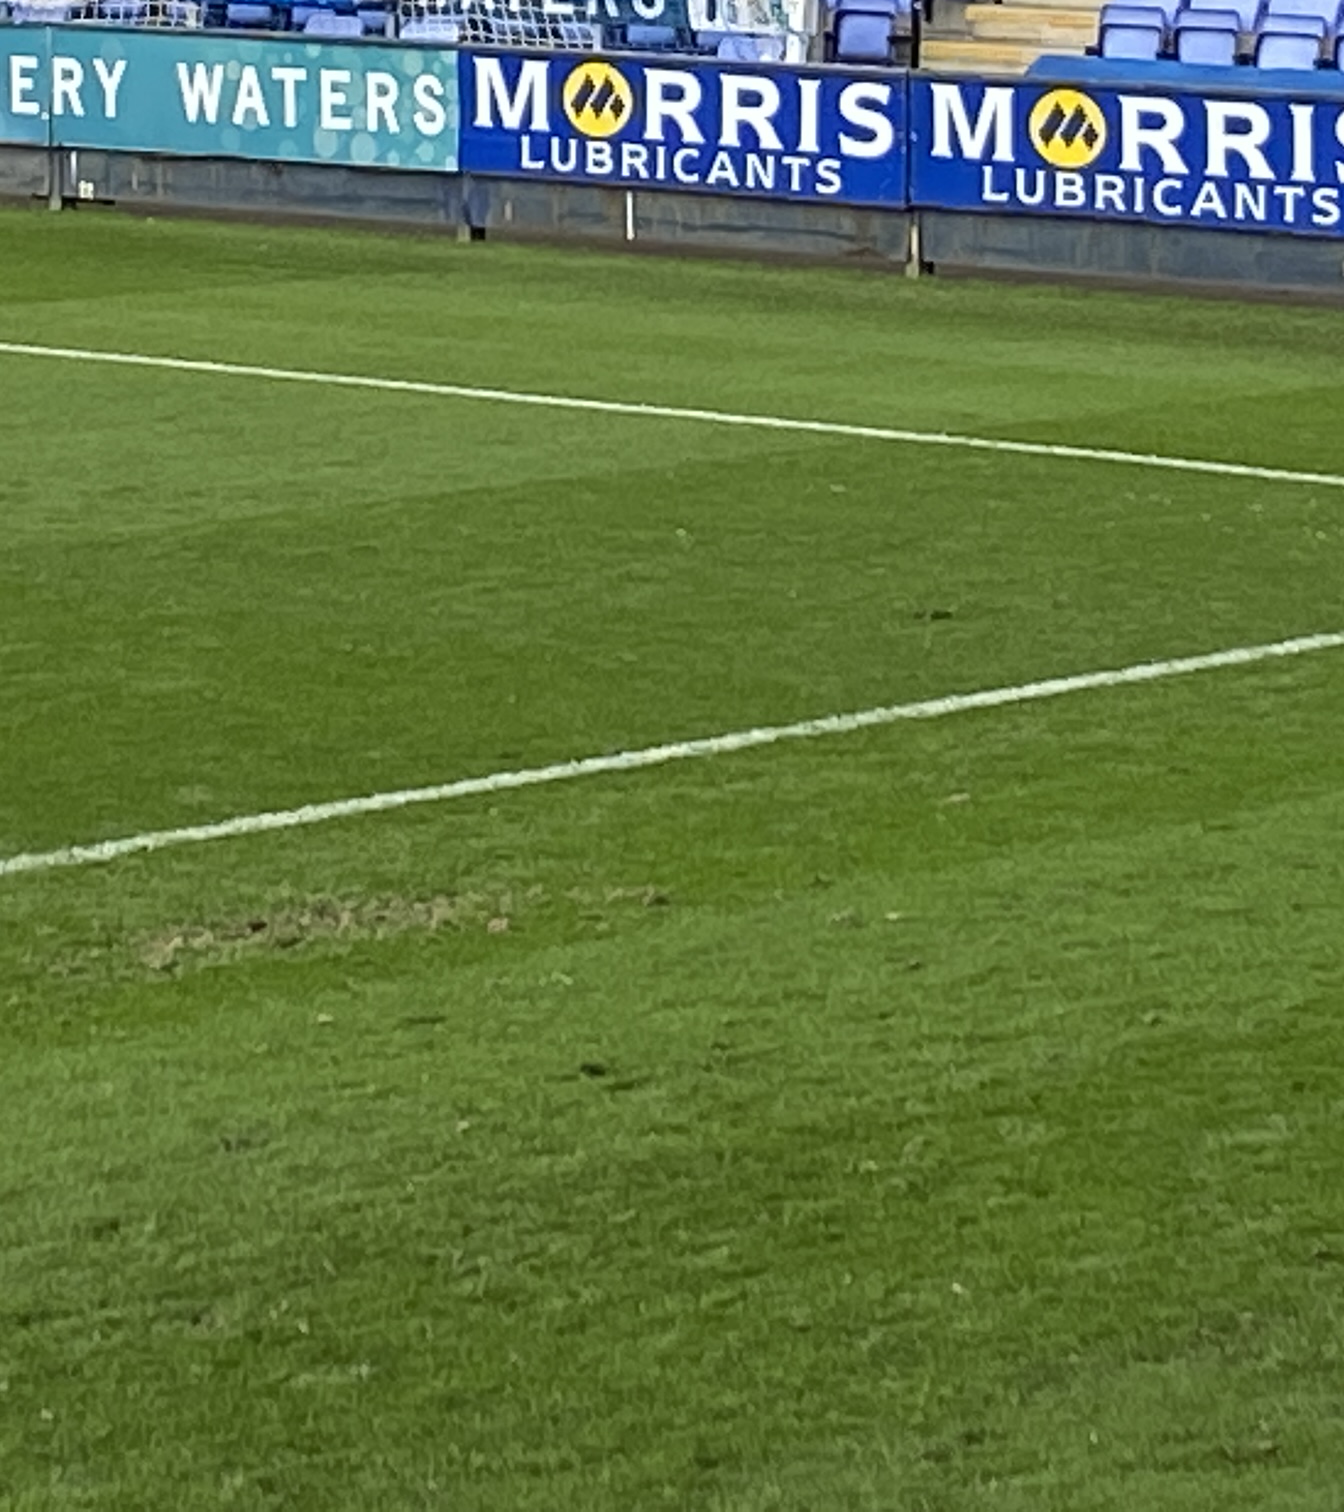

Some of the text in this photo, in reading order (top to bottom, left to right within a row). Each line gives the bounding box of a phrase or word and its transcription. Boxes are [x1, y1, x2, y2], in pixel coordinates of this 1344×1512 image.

[175, 61, 446, 135] WATERS
[472, 55, 895, 159] MORRIS
[520, 134, 843, 196] LUBRICANTS
[981, 165, 1343, 227] LUBRICANTS
